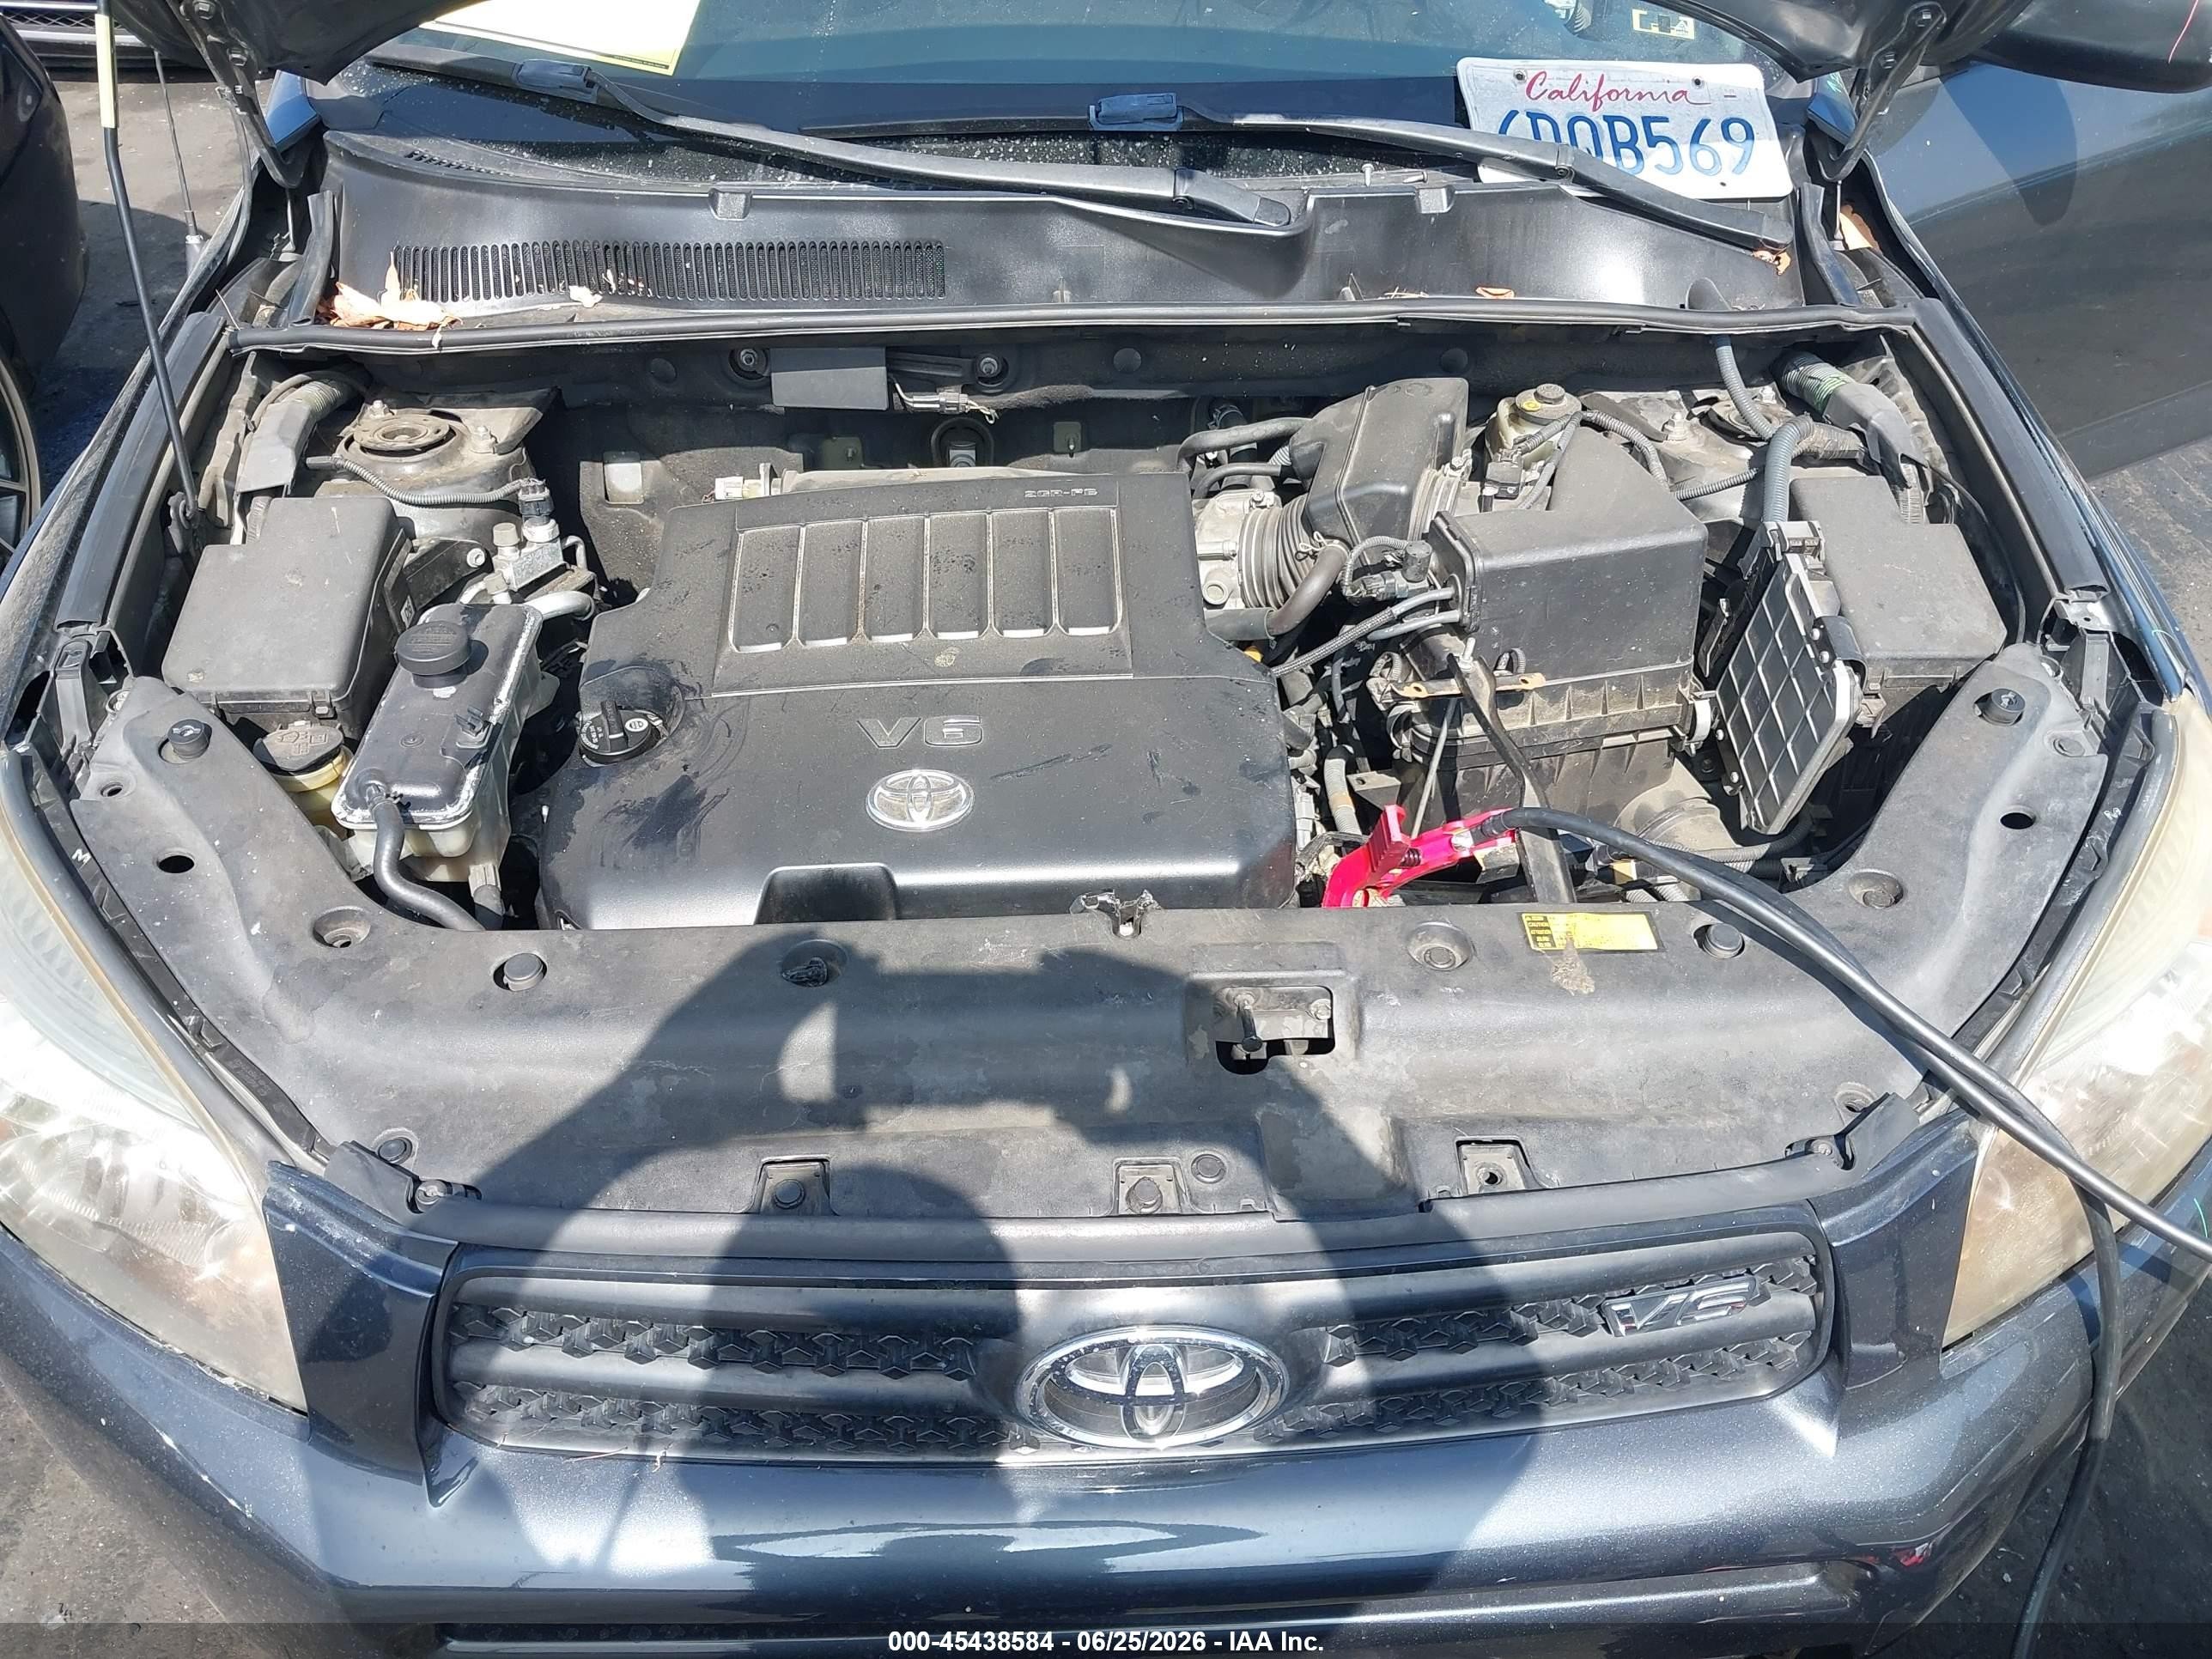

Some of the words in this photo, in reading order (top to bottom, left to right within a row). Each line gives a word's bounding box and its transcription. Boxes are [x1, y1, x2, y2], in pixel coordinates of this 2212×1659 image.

[1525, 70, 1711, 112] California
[857, 715, 984, 749] V6
[1611, 1282, 1752, 1337] V6
